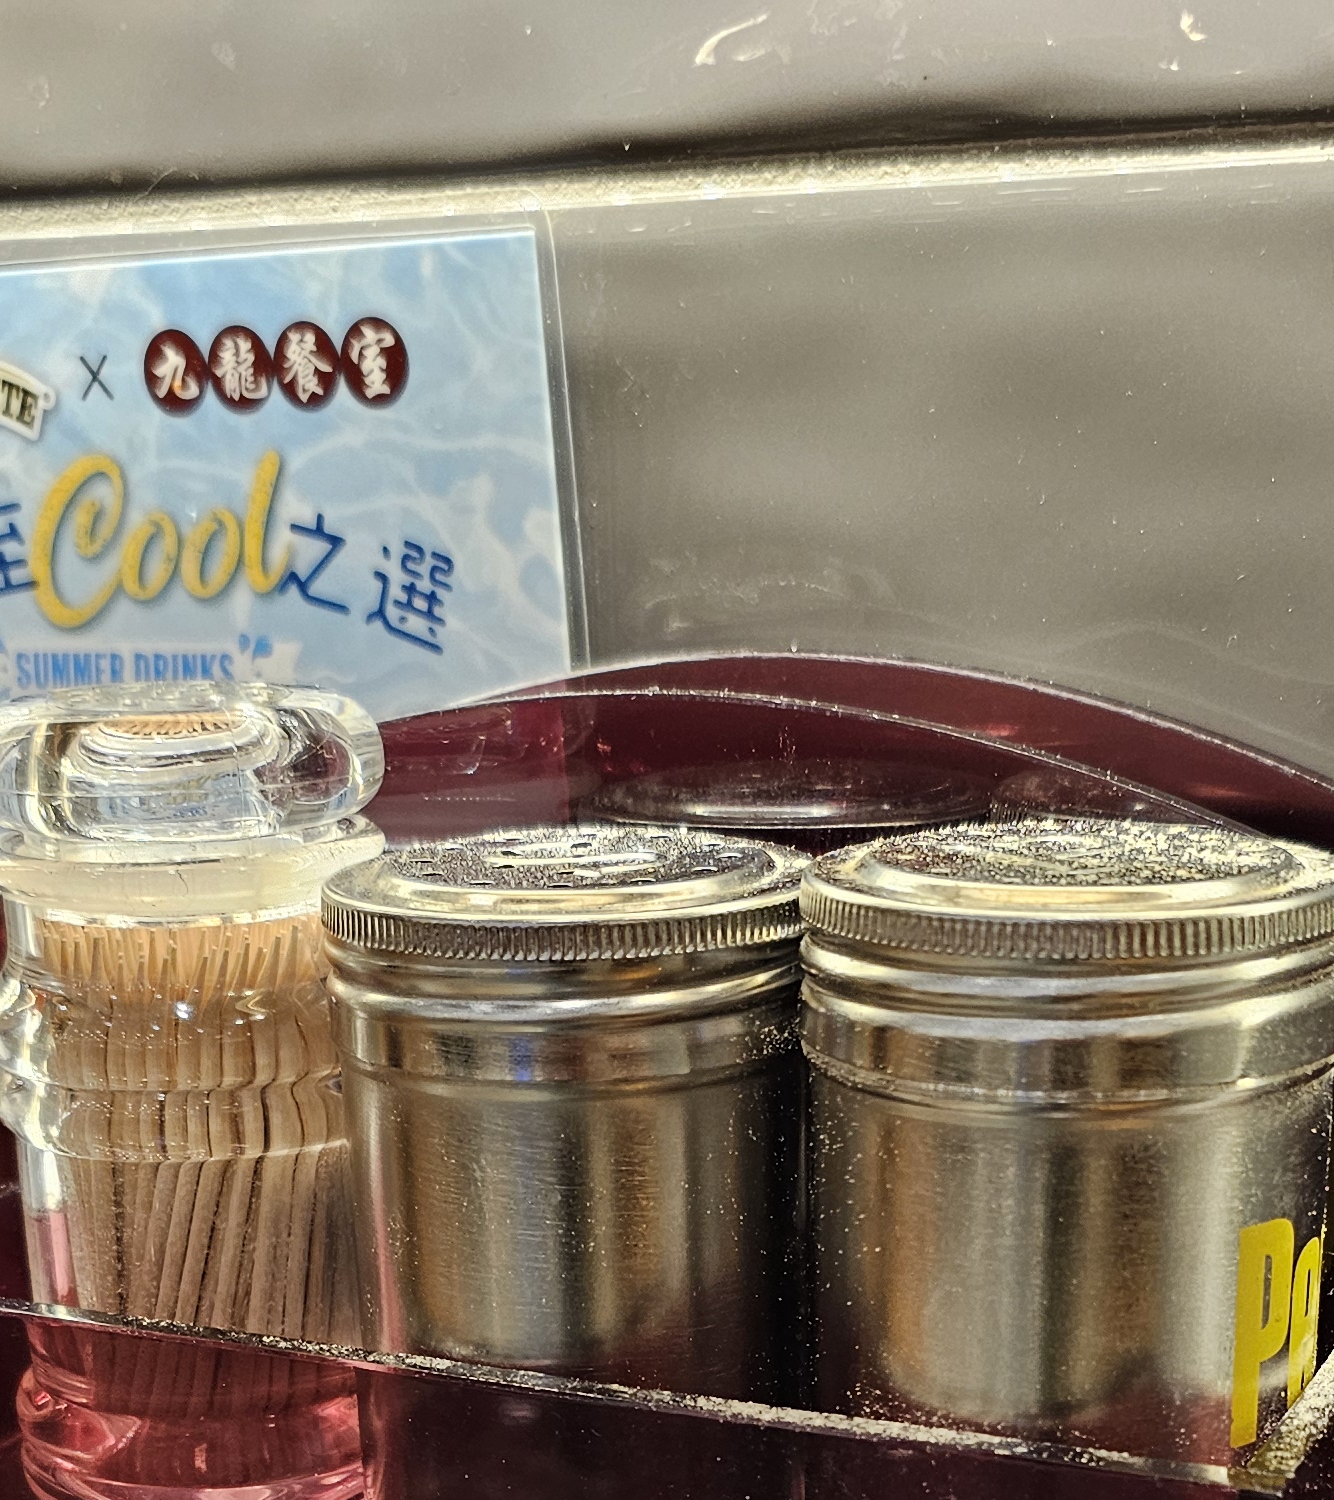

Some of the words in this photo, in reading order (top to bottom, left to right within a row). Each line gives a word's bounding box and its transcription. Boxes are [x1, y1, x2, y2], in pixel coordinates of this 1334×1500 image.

[153, 325, 400, 403] 九龍餐室
[16, 652, 124, 689] SUMMER
[134, 653, 234, 682] DRINKS
